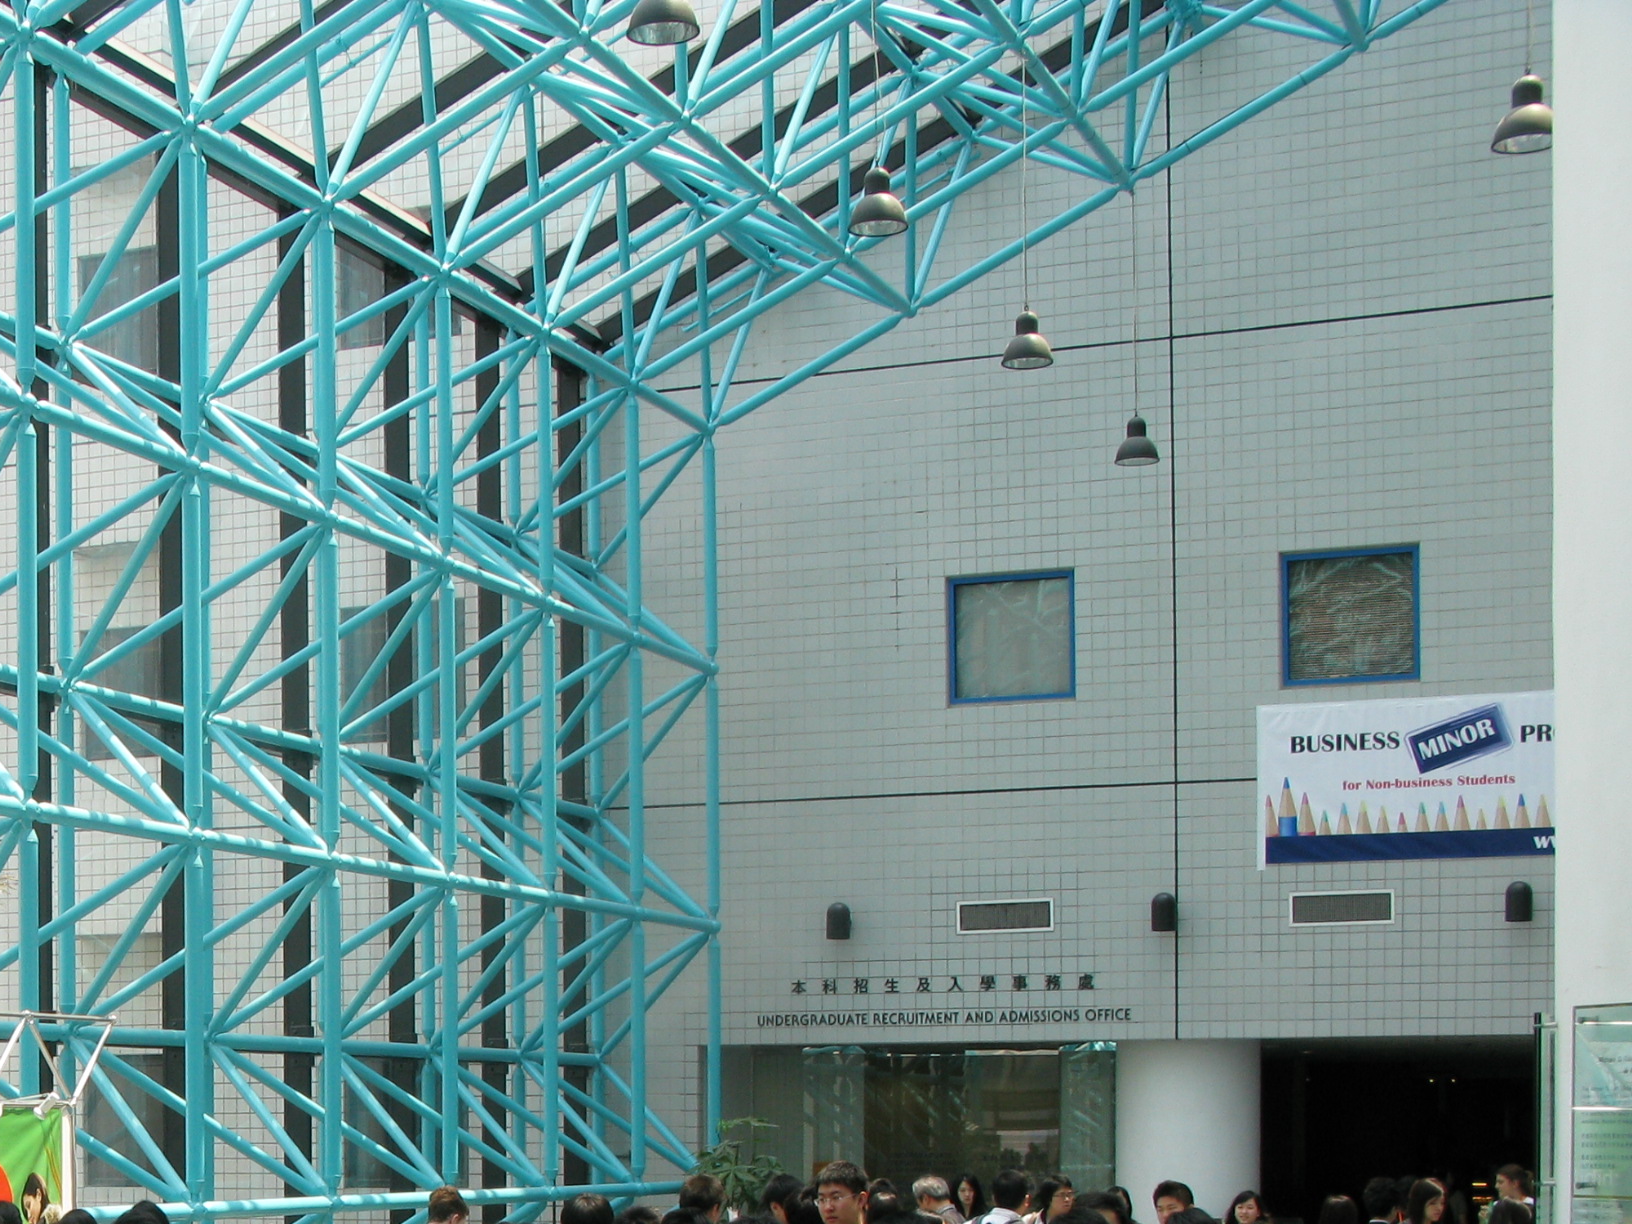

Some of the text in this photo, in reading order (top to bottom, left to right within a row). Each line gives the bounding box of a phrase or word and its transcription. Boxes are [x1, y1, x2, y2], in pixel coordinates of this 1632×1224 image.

[1290, 718, 1555, 761] BUSINESS MINOR PR
[1342, 774, 1516, 790] for Non-business Students
[791, 973, 1095, 995] 本科招生及入學事務處
[757, 1007, 1132, 1027] UNDERGRADUATE RECRUITMENT AND ADMISSIONS OFFICE
